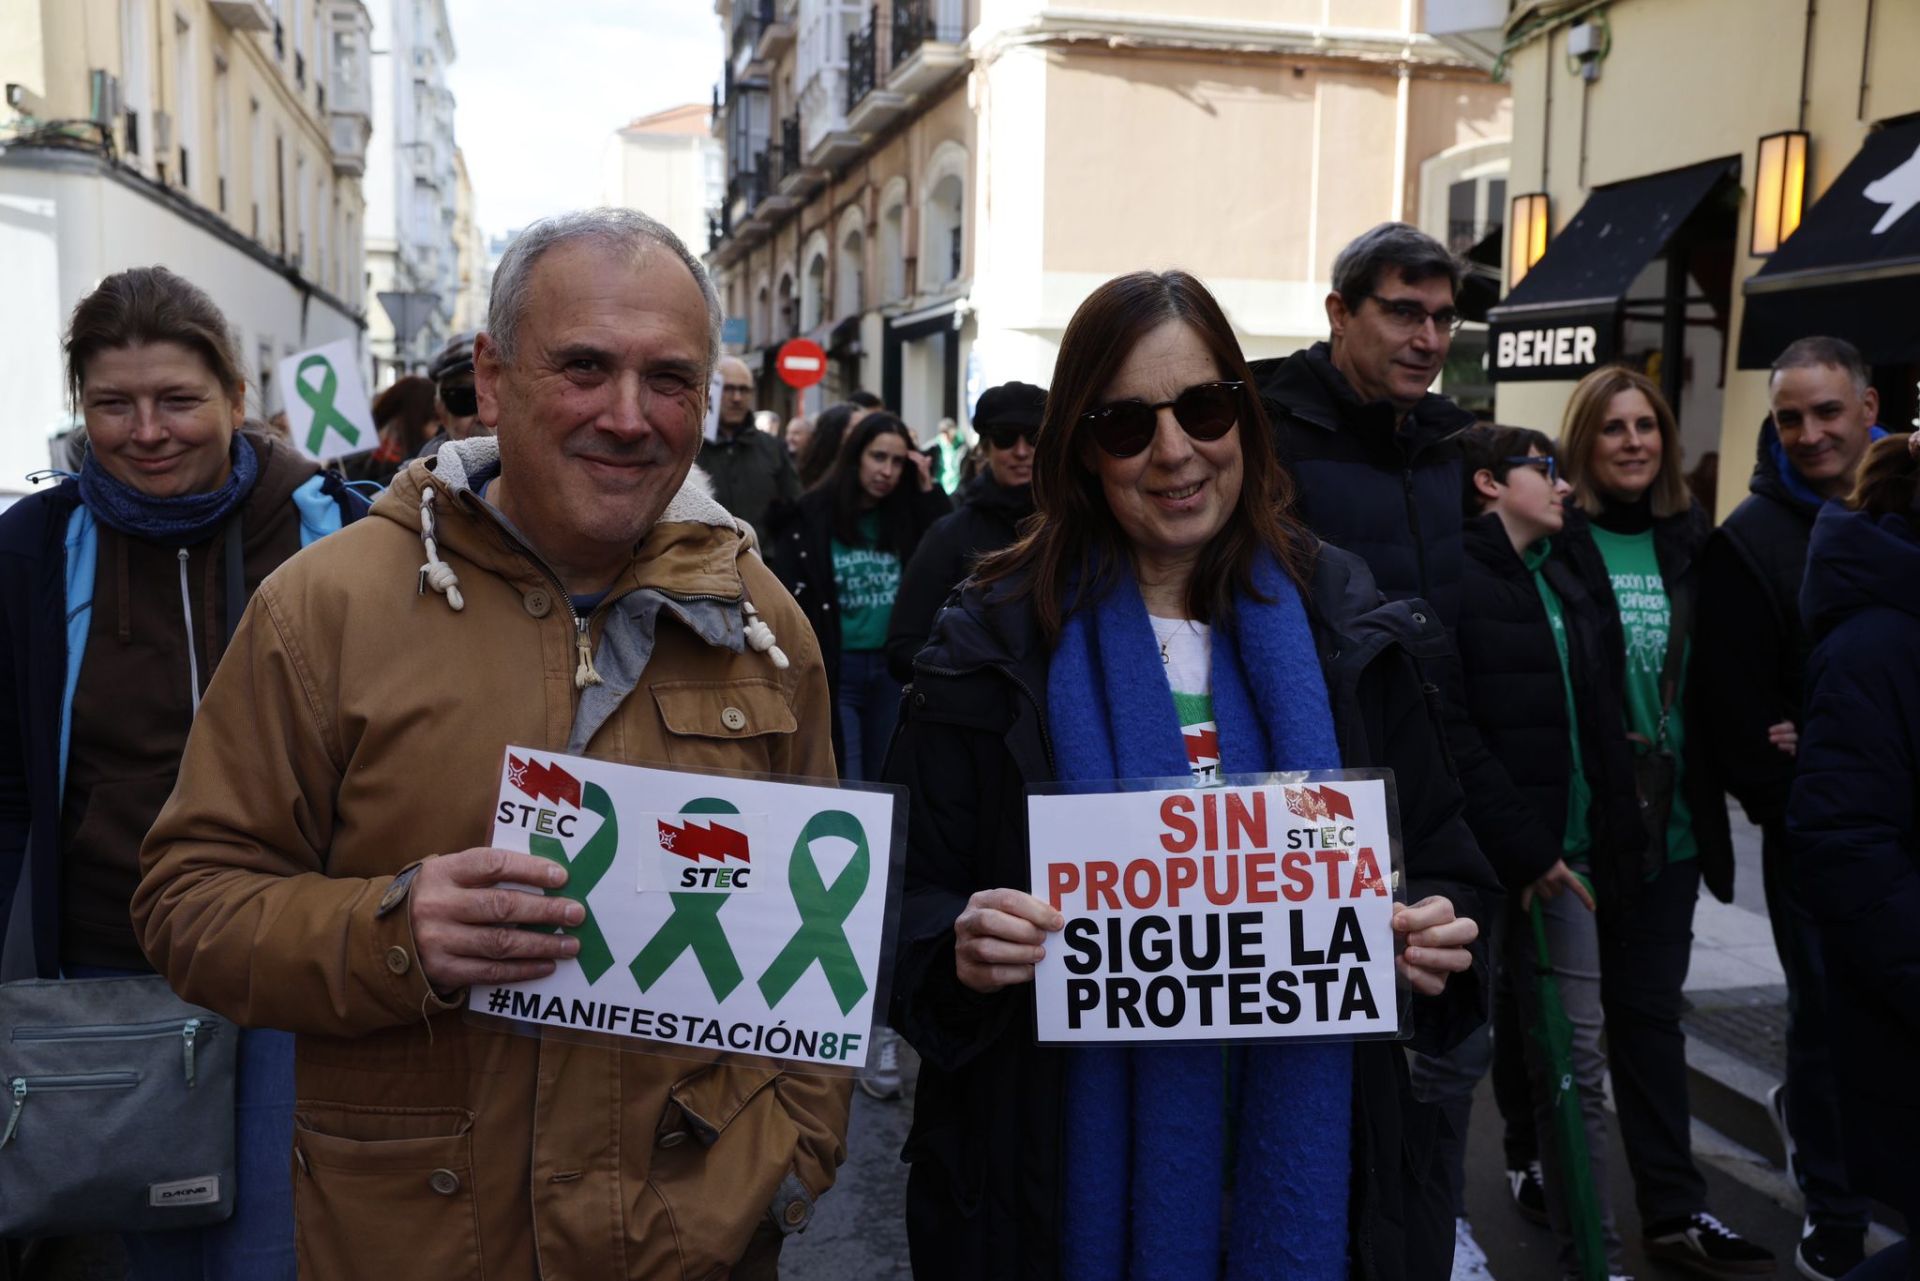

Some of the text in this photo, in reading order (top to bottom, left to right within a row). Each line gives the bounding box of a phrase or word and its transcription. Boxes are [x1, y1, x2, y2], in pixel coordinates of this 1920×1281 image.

[1497, 326, 1597, 368] BEHER
[497, 800, 578, 838] STEC
[1159, 790, 1268, 854] SIN
[1287, 825, 1357, 849] STEC
[680, 867, 751, 888] STEC
[1047, 847, 1388, 911] PROPUESTA
[1062, 906, 1371, 975] SIGUE LA
[488, 987, 862, 1061] #MANIFESTACIÓN8F
[1066, 967, 1380, 1029] PROTESTA
